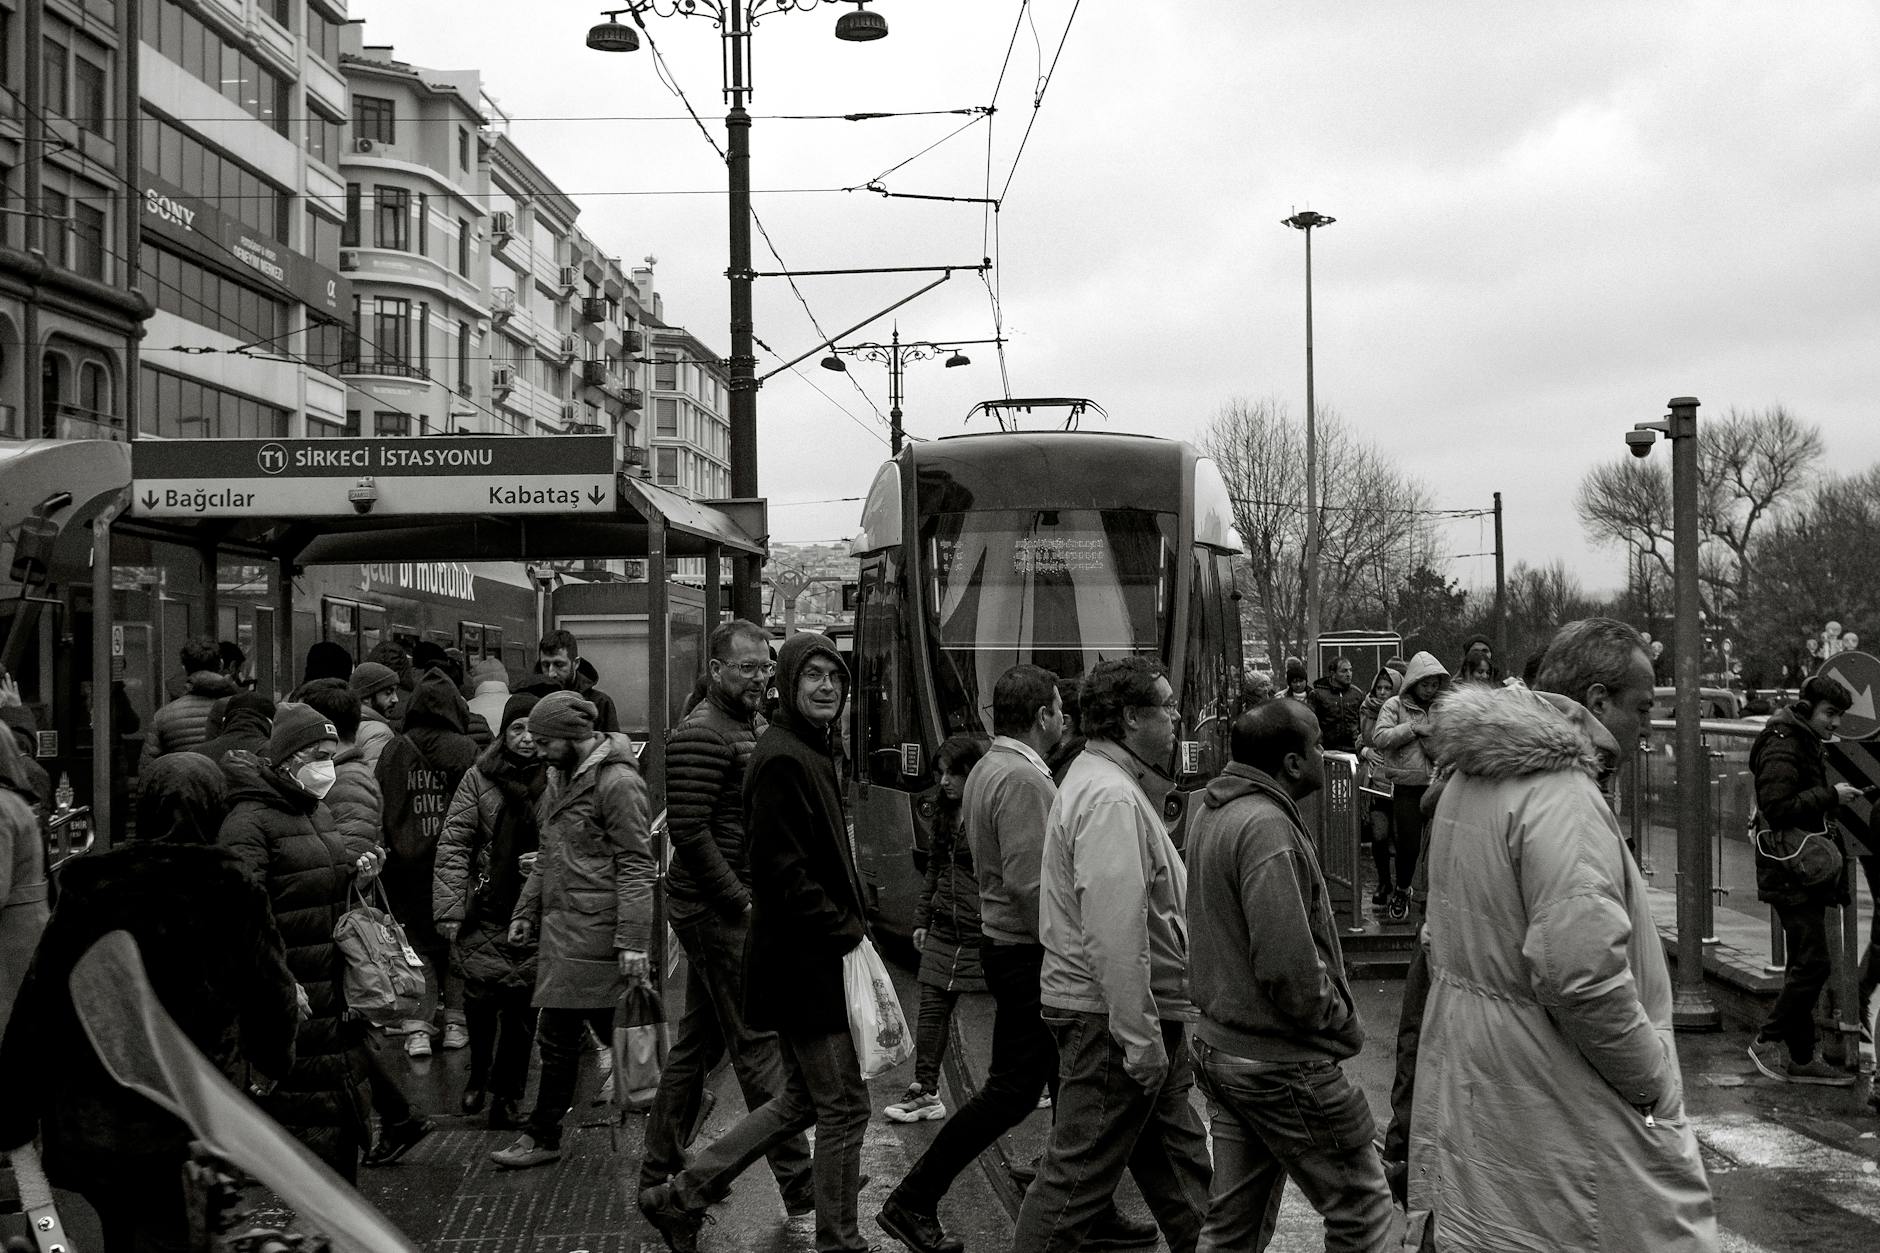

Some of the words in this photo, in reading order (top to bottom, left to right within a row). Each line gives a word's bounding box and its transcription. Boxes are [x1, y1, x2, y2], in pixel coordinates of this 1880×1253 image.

[147, 189, 195, 231] SONY
[261, 451, 283, 467] T1
[295, 446, 370, 467] SİRKECİ
[379, 446, 493, 467] İSTASYONU
[165, 488, 255, 512] Bağcılar
[489, 485, 580, 509] Kabataş
[416, 562, 475, 601] mutluluk
[407, 770, 447, 790] NEVER
[413, 794, 444, 814] GIVE
[422, 816, 440, 836] UP
